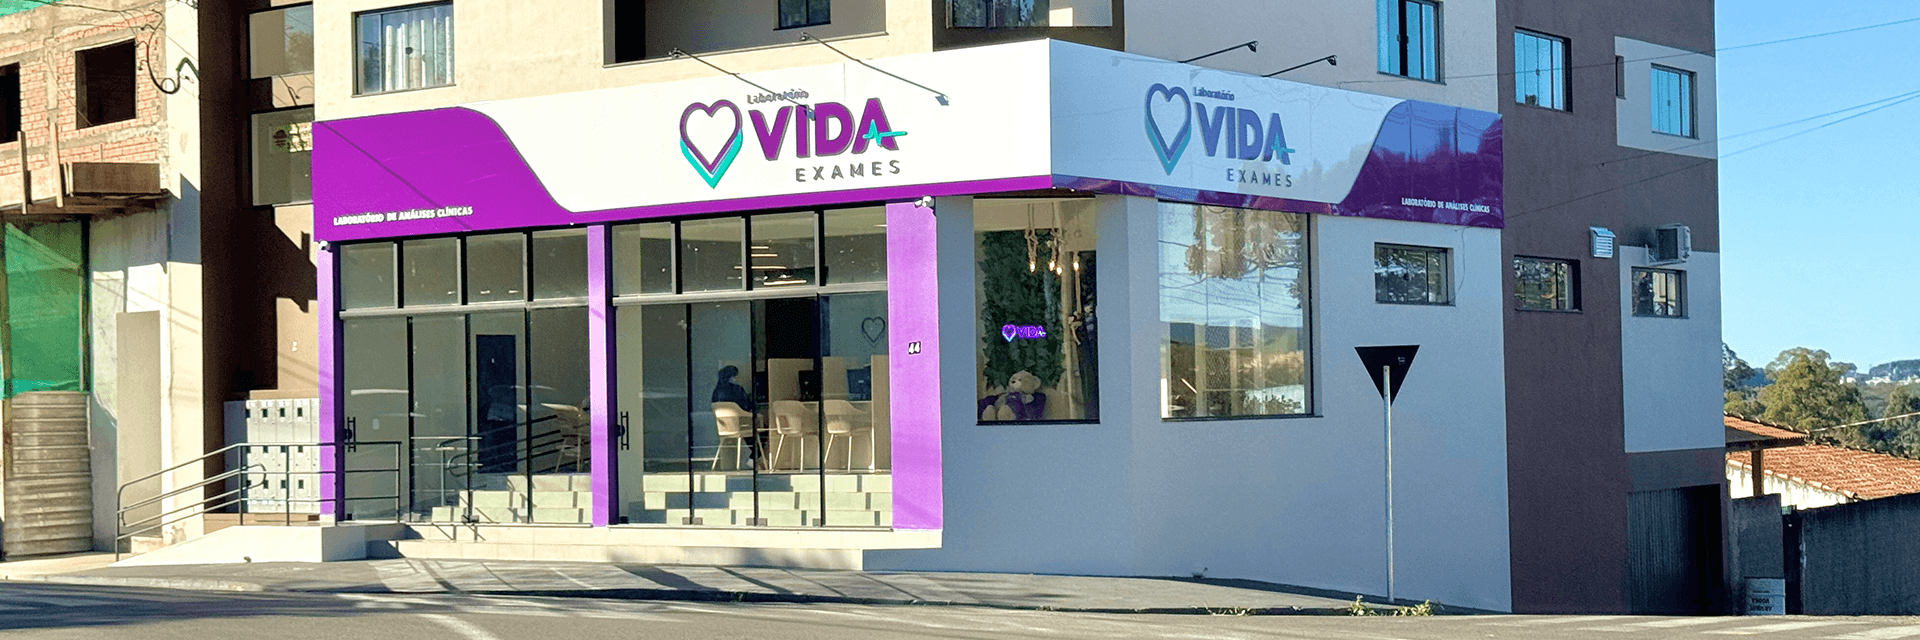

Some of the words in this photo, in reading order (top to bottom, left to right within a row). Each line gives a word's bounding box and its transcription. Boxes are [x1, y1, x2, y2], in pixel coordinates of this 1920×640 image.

[747, 88, 809, 104] Laboratório
[1192, 87, 1235, 101] Laboratório
[748, 98, 901, 161] VIDA
[1194, 102, 1291, 165] VIDA
[796, 160, 900, 182] EXAMES
[1226, 168, 1292, 188] EXAMES
[1401, 197, 1436, 208] LABORATÓRIO
[1437, 201, 1445, 209] DE
[1445, 200, 1469, 211] ANÁLISES
[1469, 203, 1490, 213] CLÍNICAS
[333, 213, 385, 226] LABORATÓRIO
[386, 212, 398, 222] DE
[398, 208, 436, 221] ANÁLISES
[436, 206, 473, 218] CLÍNICAS
[1016, 325, 1046, 338] VIDA
[908, 341, 921, 354] 44
